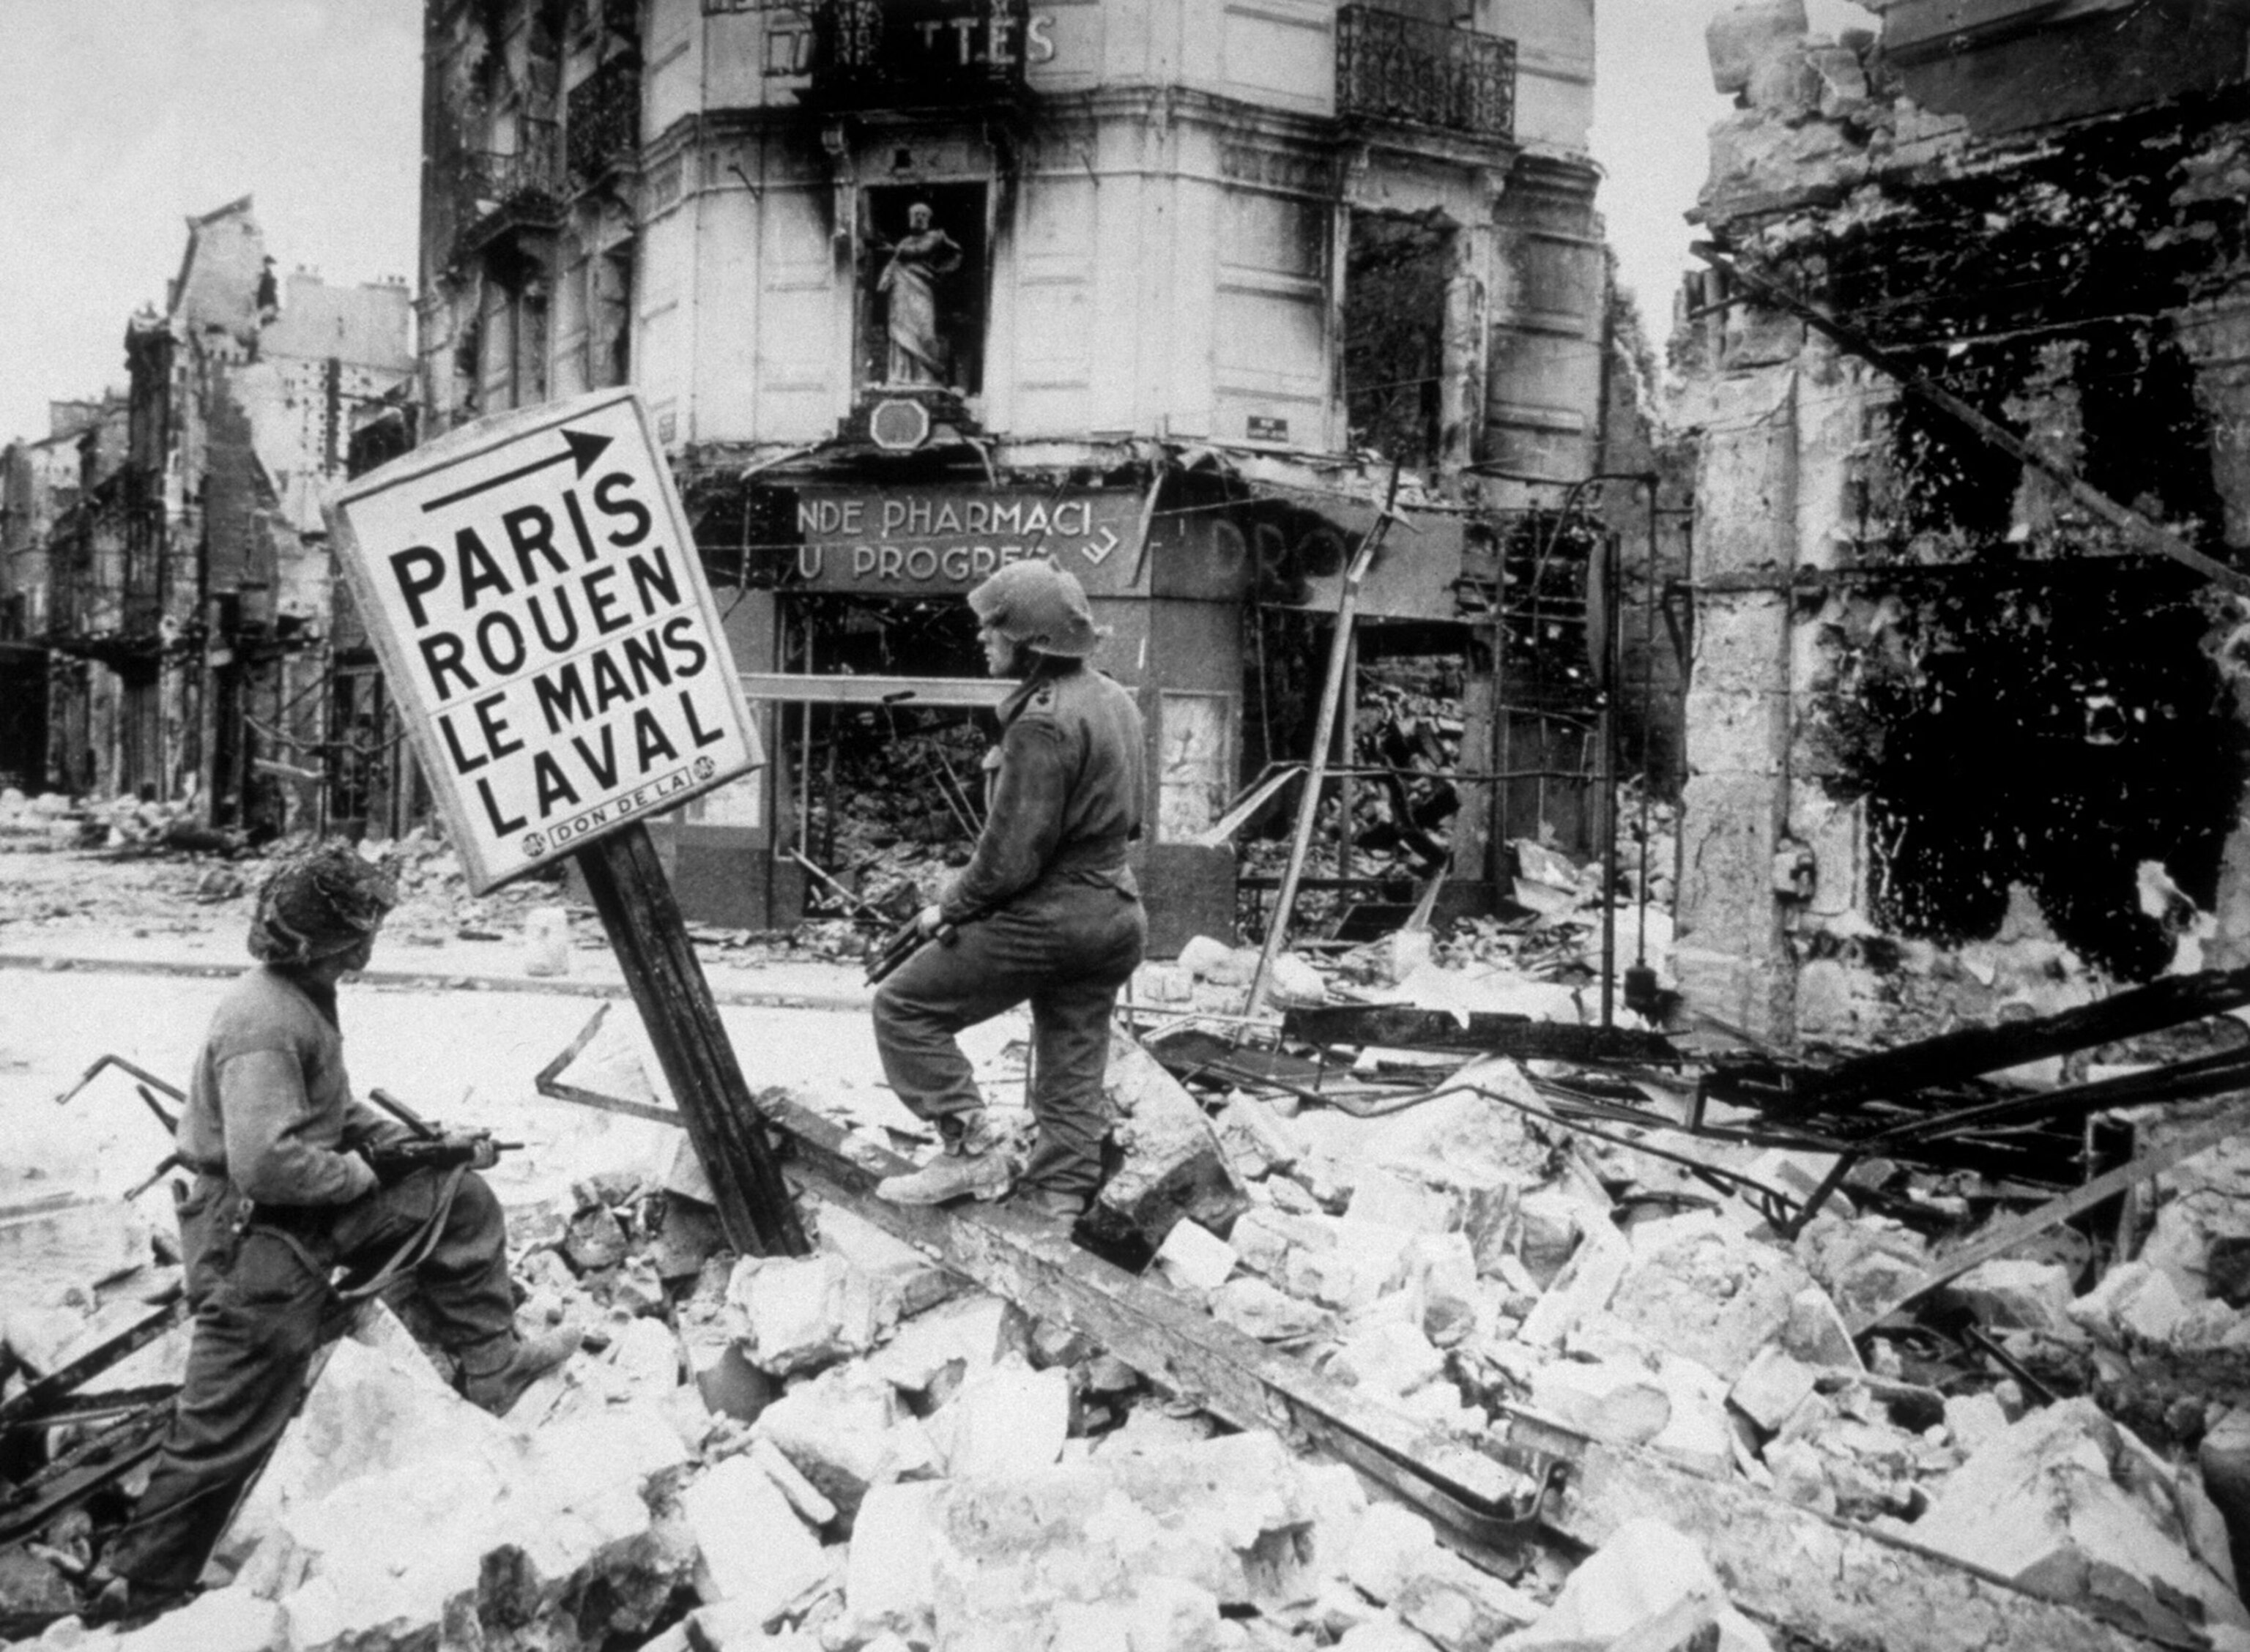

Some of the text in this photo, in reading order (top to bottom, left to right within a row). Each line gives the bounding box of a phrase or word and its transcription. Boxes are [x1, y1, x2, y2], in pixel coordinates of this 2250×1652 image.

[389, 472, 651, 628] PARIS
[798, 500, 864, 535] NDE
[418, 546, 681, 701] ROUEN
[439, 617, 707, 775] LE MANS
[476, 691, 724, 838] LAVAL
[557, 775, 685, 841] DON DE LA
